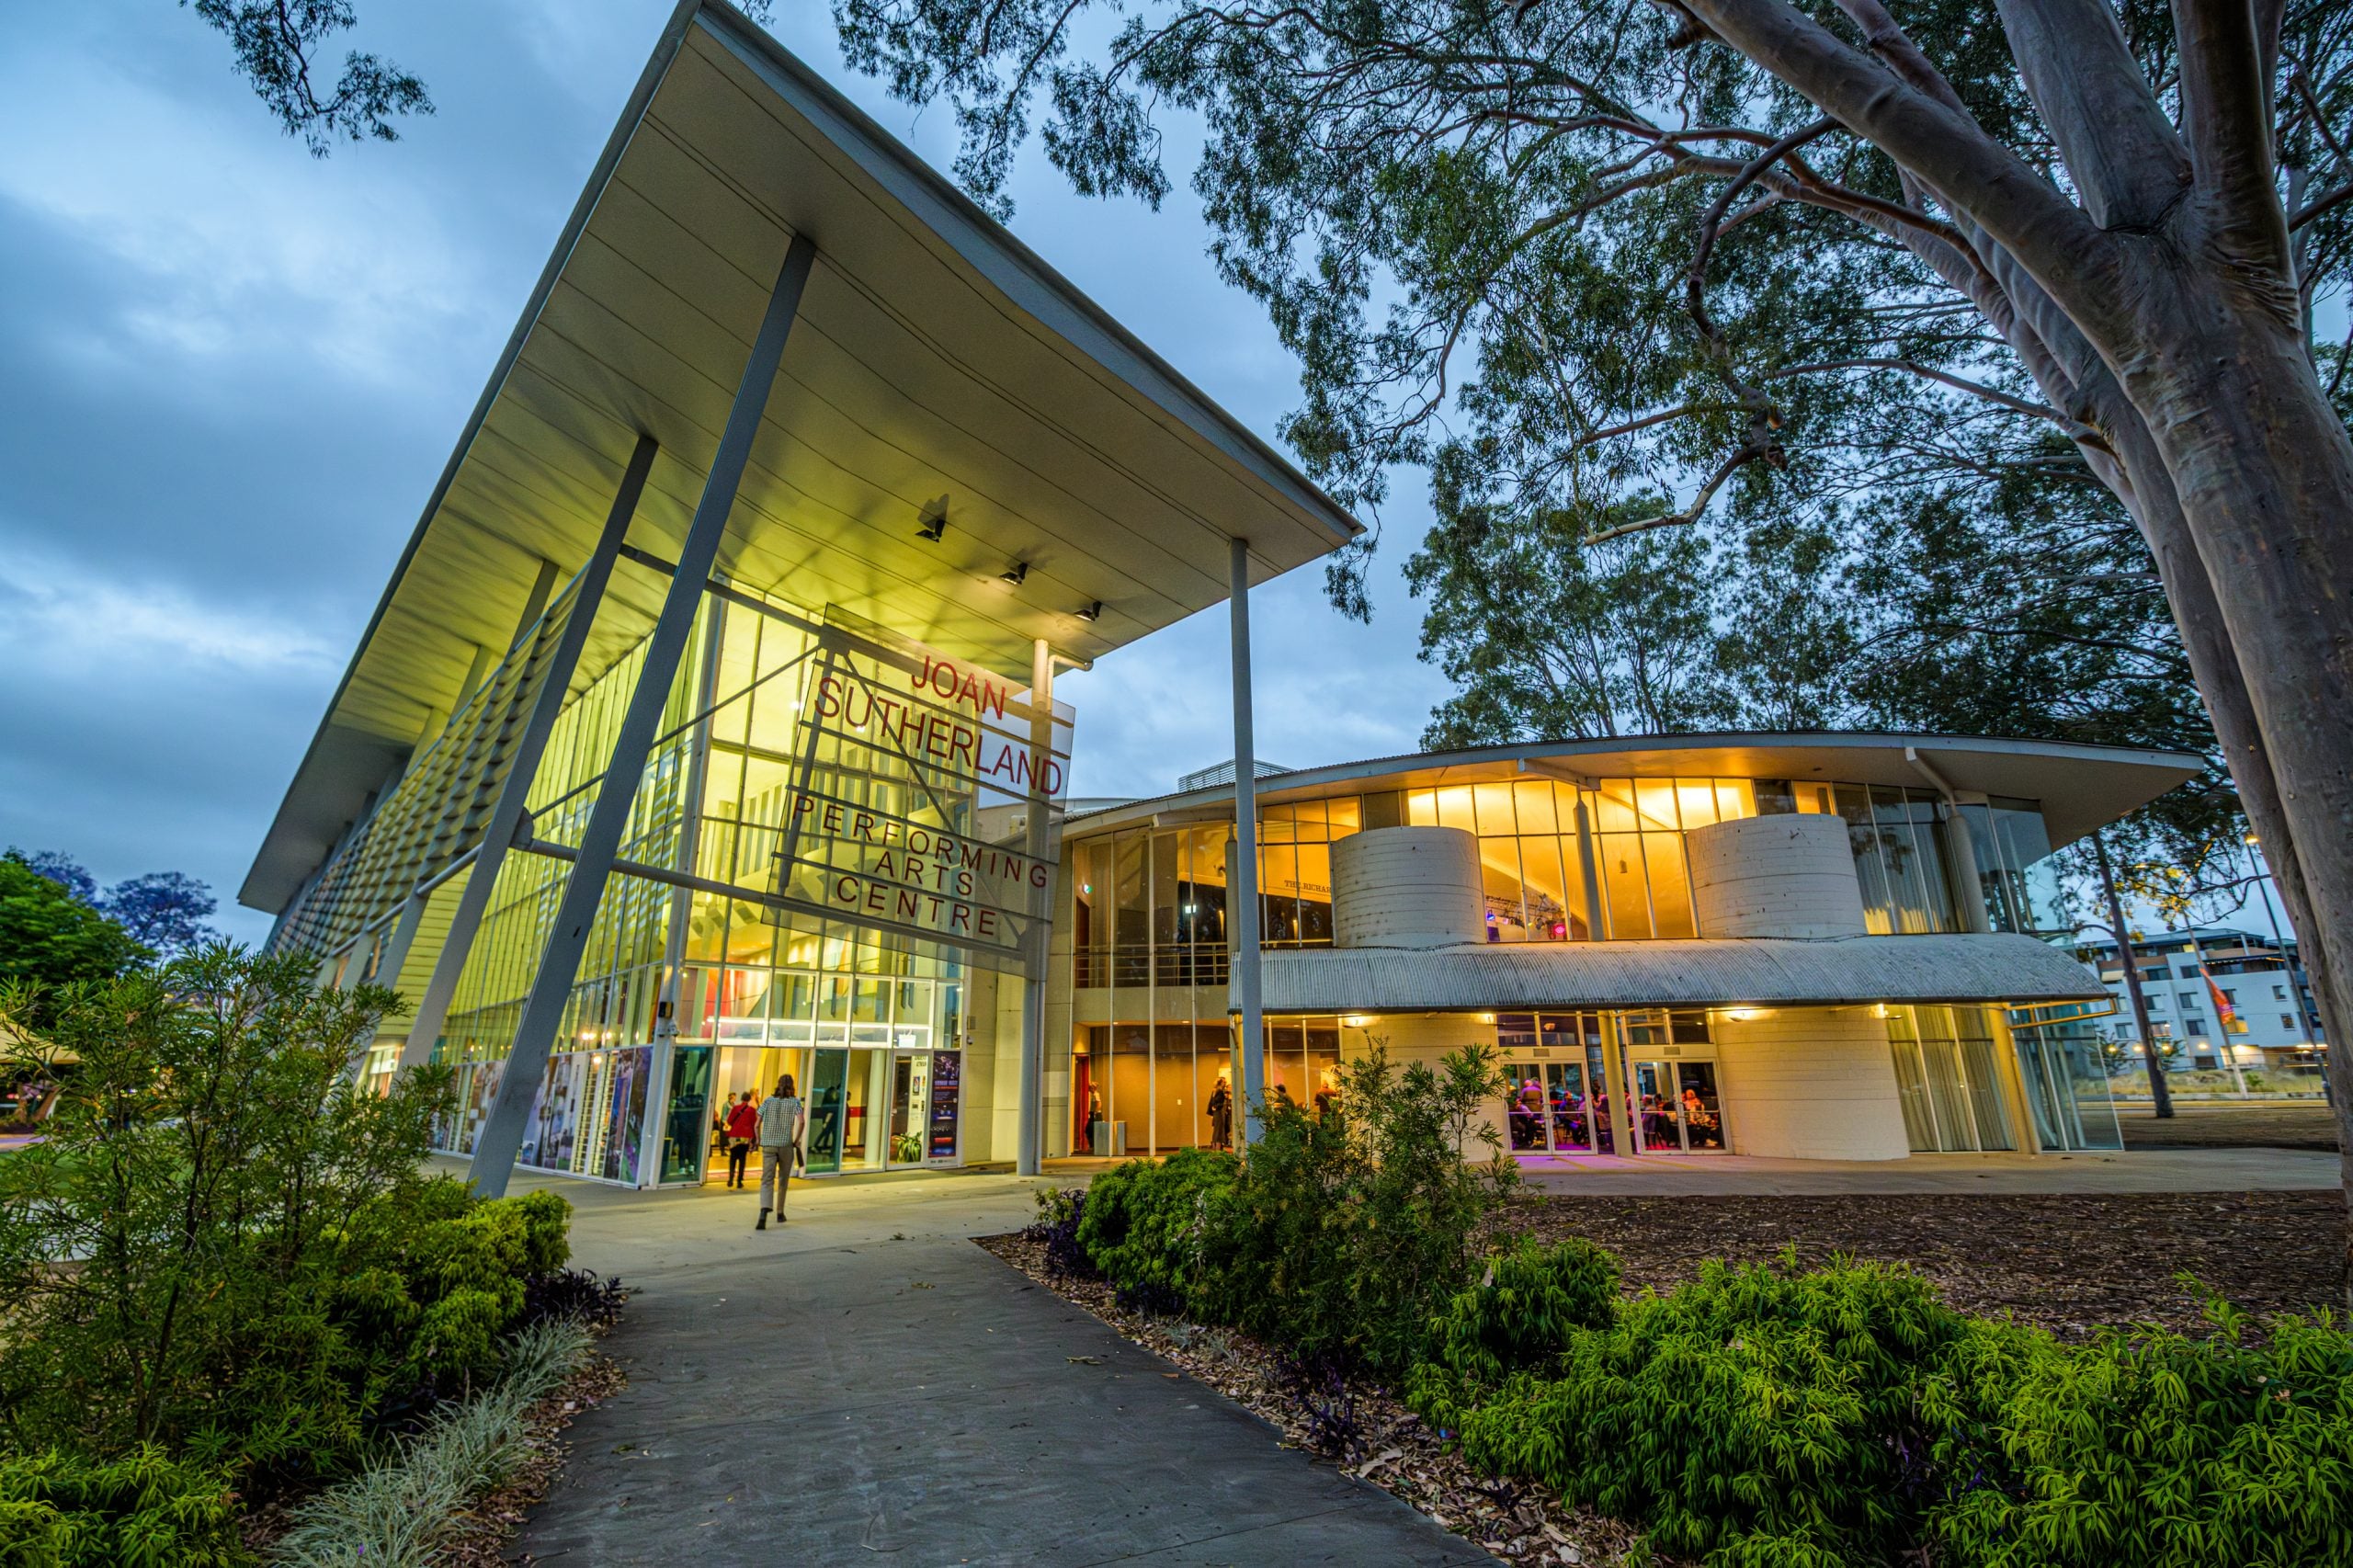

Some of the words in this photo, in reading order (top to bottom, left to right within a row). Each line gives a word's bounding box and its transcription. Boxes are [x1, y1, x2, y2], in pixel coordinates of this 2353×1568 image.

[912, 654, 1006, 721] JOAN
[814, 676, 1062, 796] SUTHERLAND
[792, 795, 1048, 889] PERFORMING
[874, 851, 973, 896] ARTS
[836, 876, 996, 936] CENTRE
